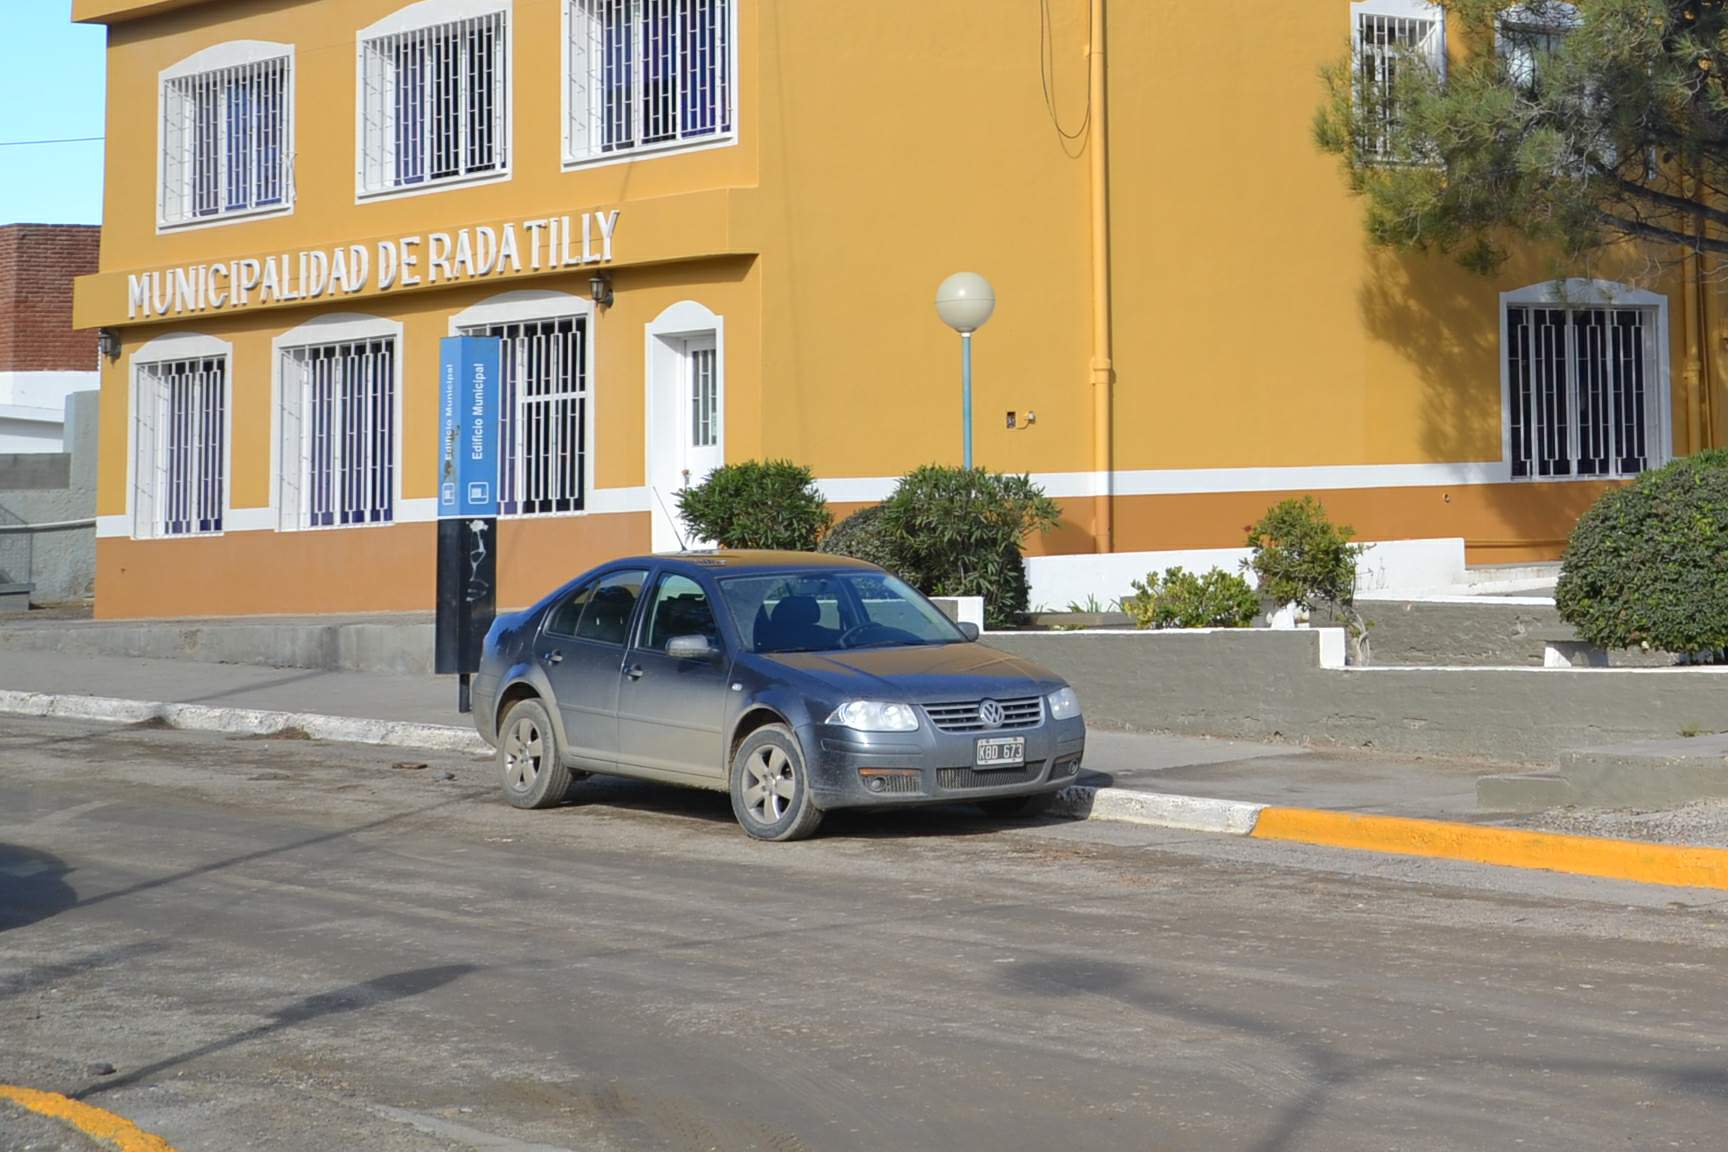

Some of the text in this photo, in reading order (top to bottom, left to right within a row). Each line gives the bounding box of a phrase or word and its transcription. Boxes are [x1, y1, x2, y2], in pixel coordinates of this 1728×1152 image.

[127, 209, 621, 319] MUNICIPALIDAD DE RADA TILLY
[445, 364, 454, 416] Municipal
[472, 363, 486, 460] Edificio Municipal
[1003, 743, 1022, 758] 673
